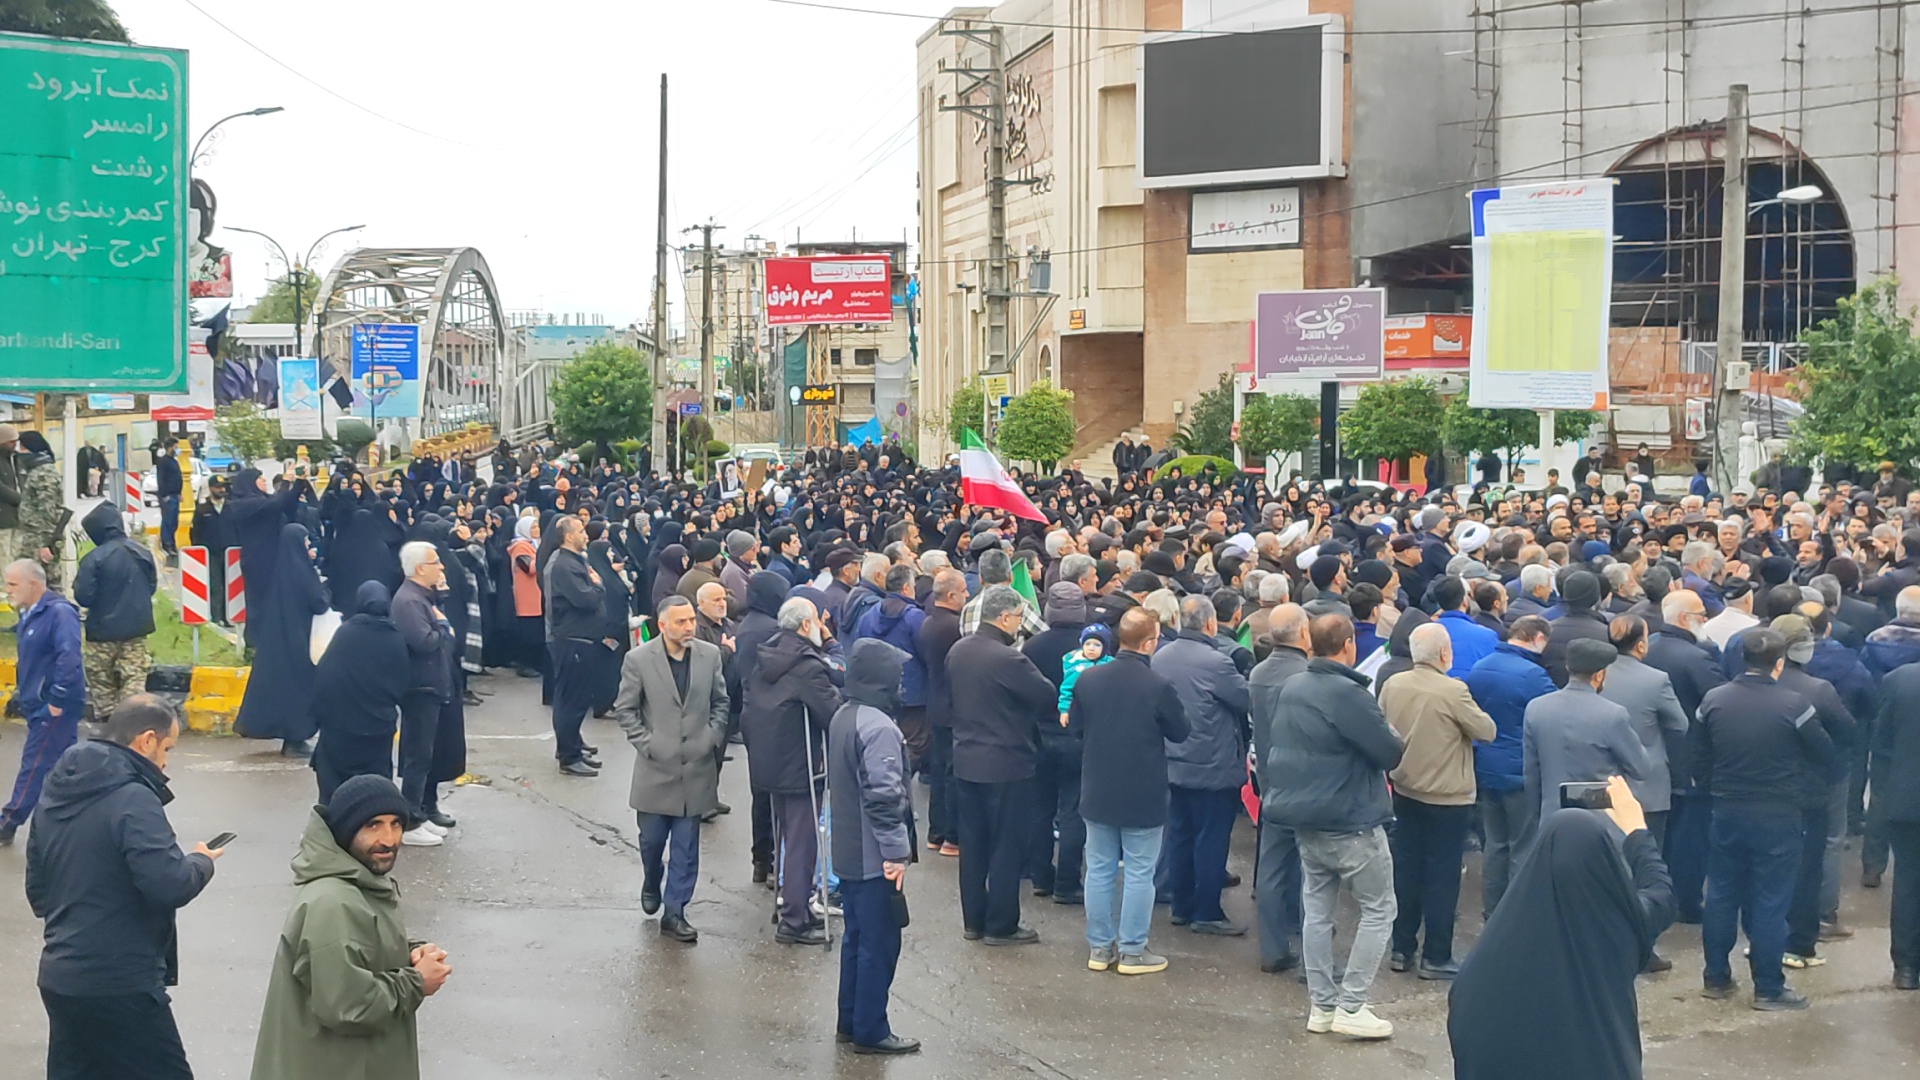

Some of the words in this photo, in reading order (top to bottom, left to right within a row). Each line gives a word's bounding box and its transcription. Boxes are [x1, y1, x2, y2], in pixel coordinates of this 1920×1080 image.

[83, 113, 168, 141] رامسر
[91, 155, 168, 185] رشت
[1269, 199, 1292, 213] رزرو
[854, 266, 883, 280] میکاپ
[767, 283, 799, 307] وثوق
[801, 288, 833, 307] مریم
[1279, 353, 1304, 364] خیابان
